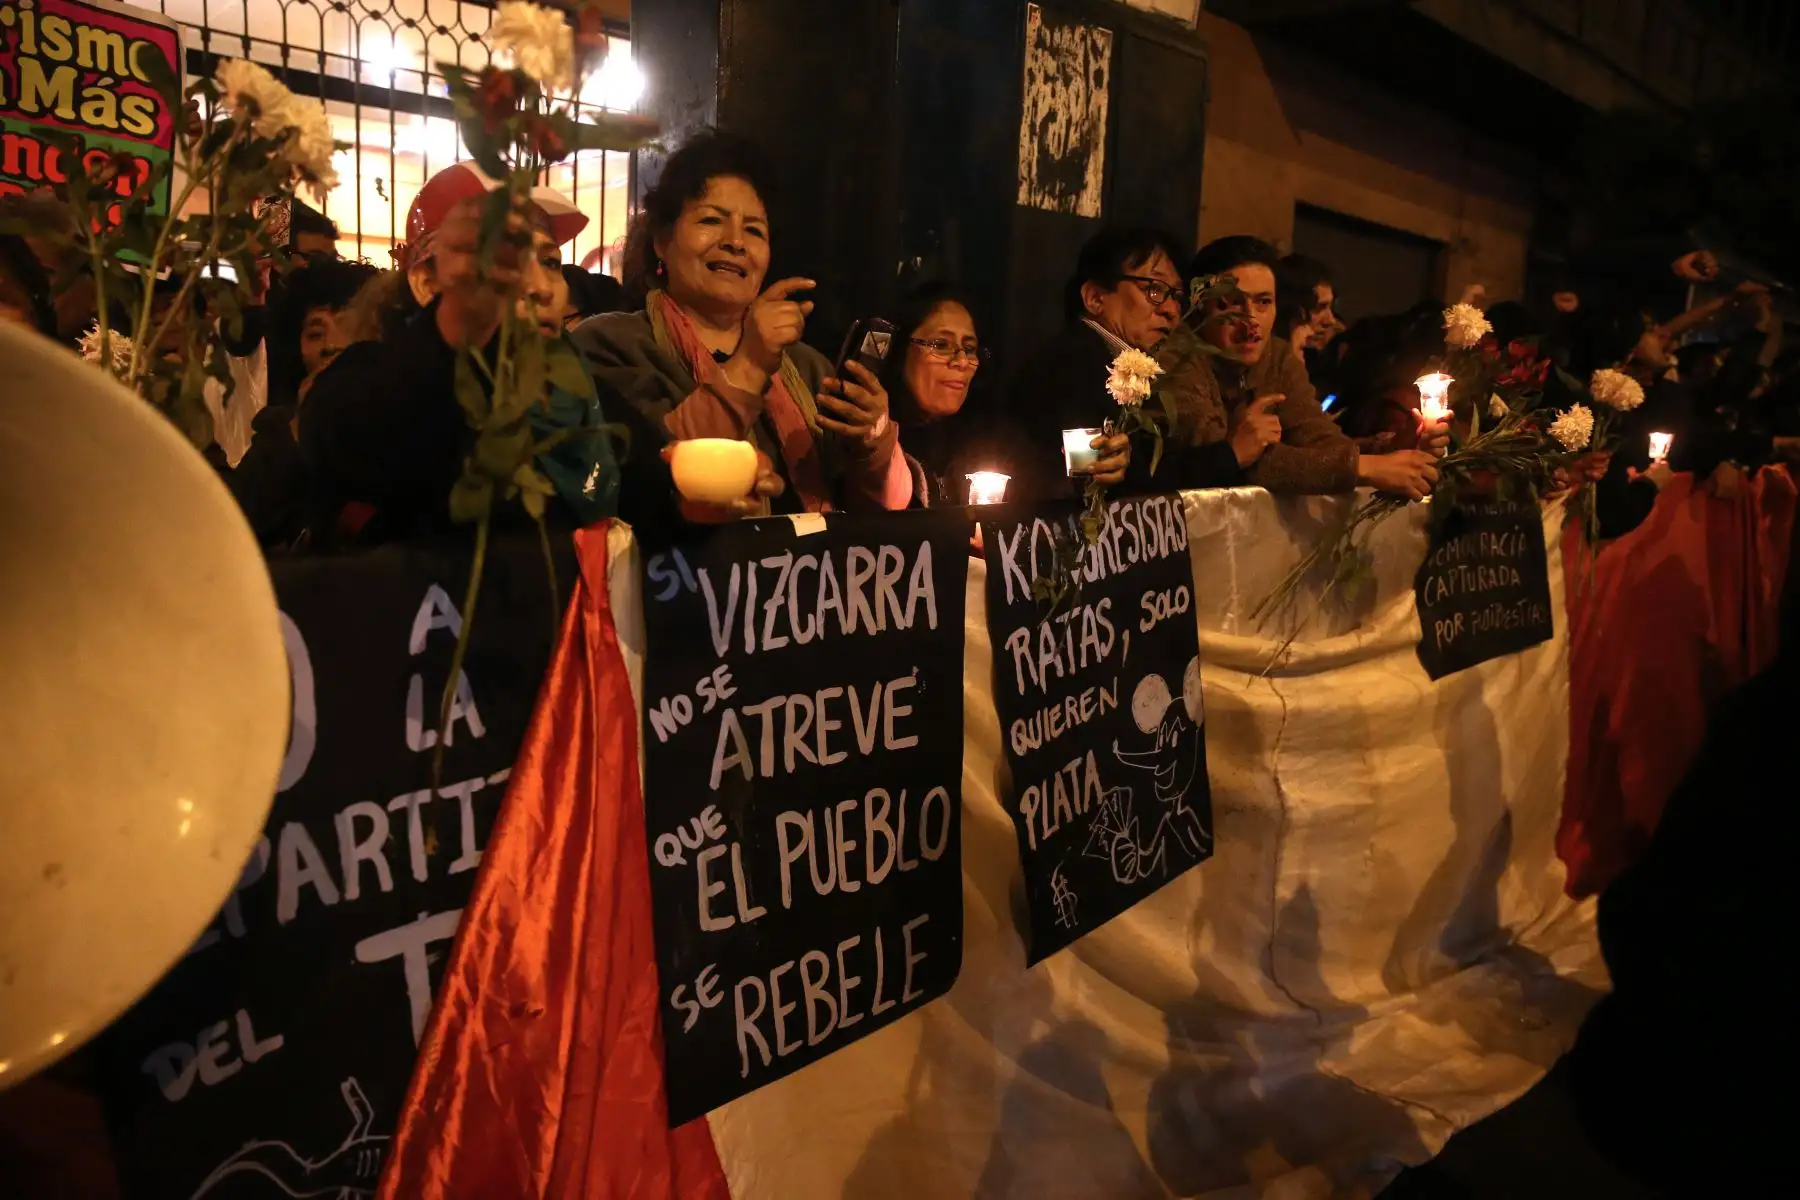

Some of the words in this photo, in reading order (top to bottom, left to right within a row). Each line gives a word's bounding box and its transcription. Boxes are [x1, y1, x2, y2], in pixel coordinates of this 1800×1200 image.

[17, 56, 155, 136] Más
[409, 584, 470, 656] A
[647, 548, 696, 600] SI
[697, 541, 937, 657] VIZCARRA
[1139, 585, 1189, 633] SOLO
[1425, 565, 1520, 607] CAPTURADA
[1435, 612, 1464, 652] POR
[406, 668, 487, 752] LA
[650, 694, 693, 743] NO
[696, 664, 737, 713] SE
[1011, 677, 1118, 756] QUIEREN
[1020, 750, 1103, 850] PLATA
[655, 804, 727, 866] QUE
[697, 841, 767, 931] EL
[775, 786, 950, 909] PUEBLO
[671, 963, 724, 1033] SE
[734, 914, 929, 1078] REBELE
[141, 1008, 284, 1101] DEL
